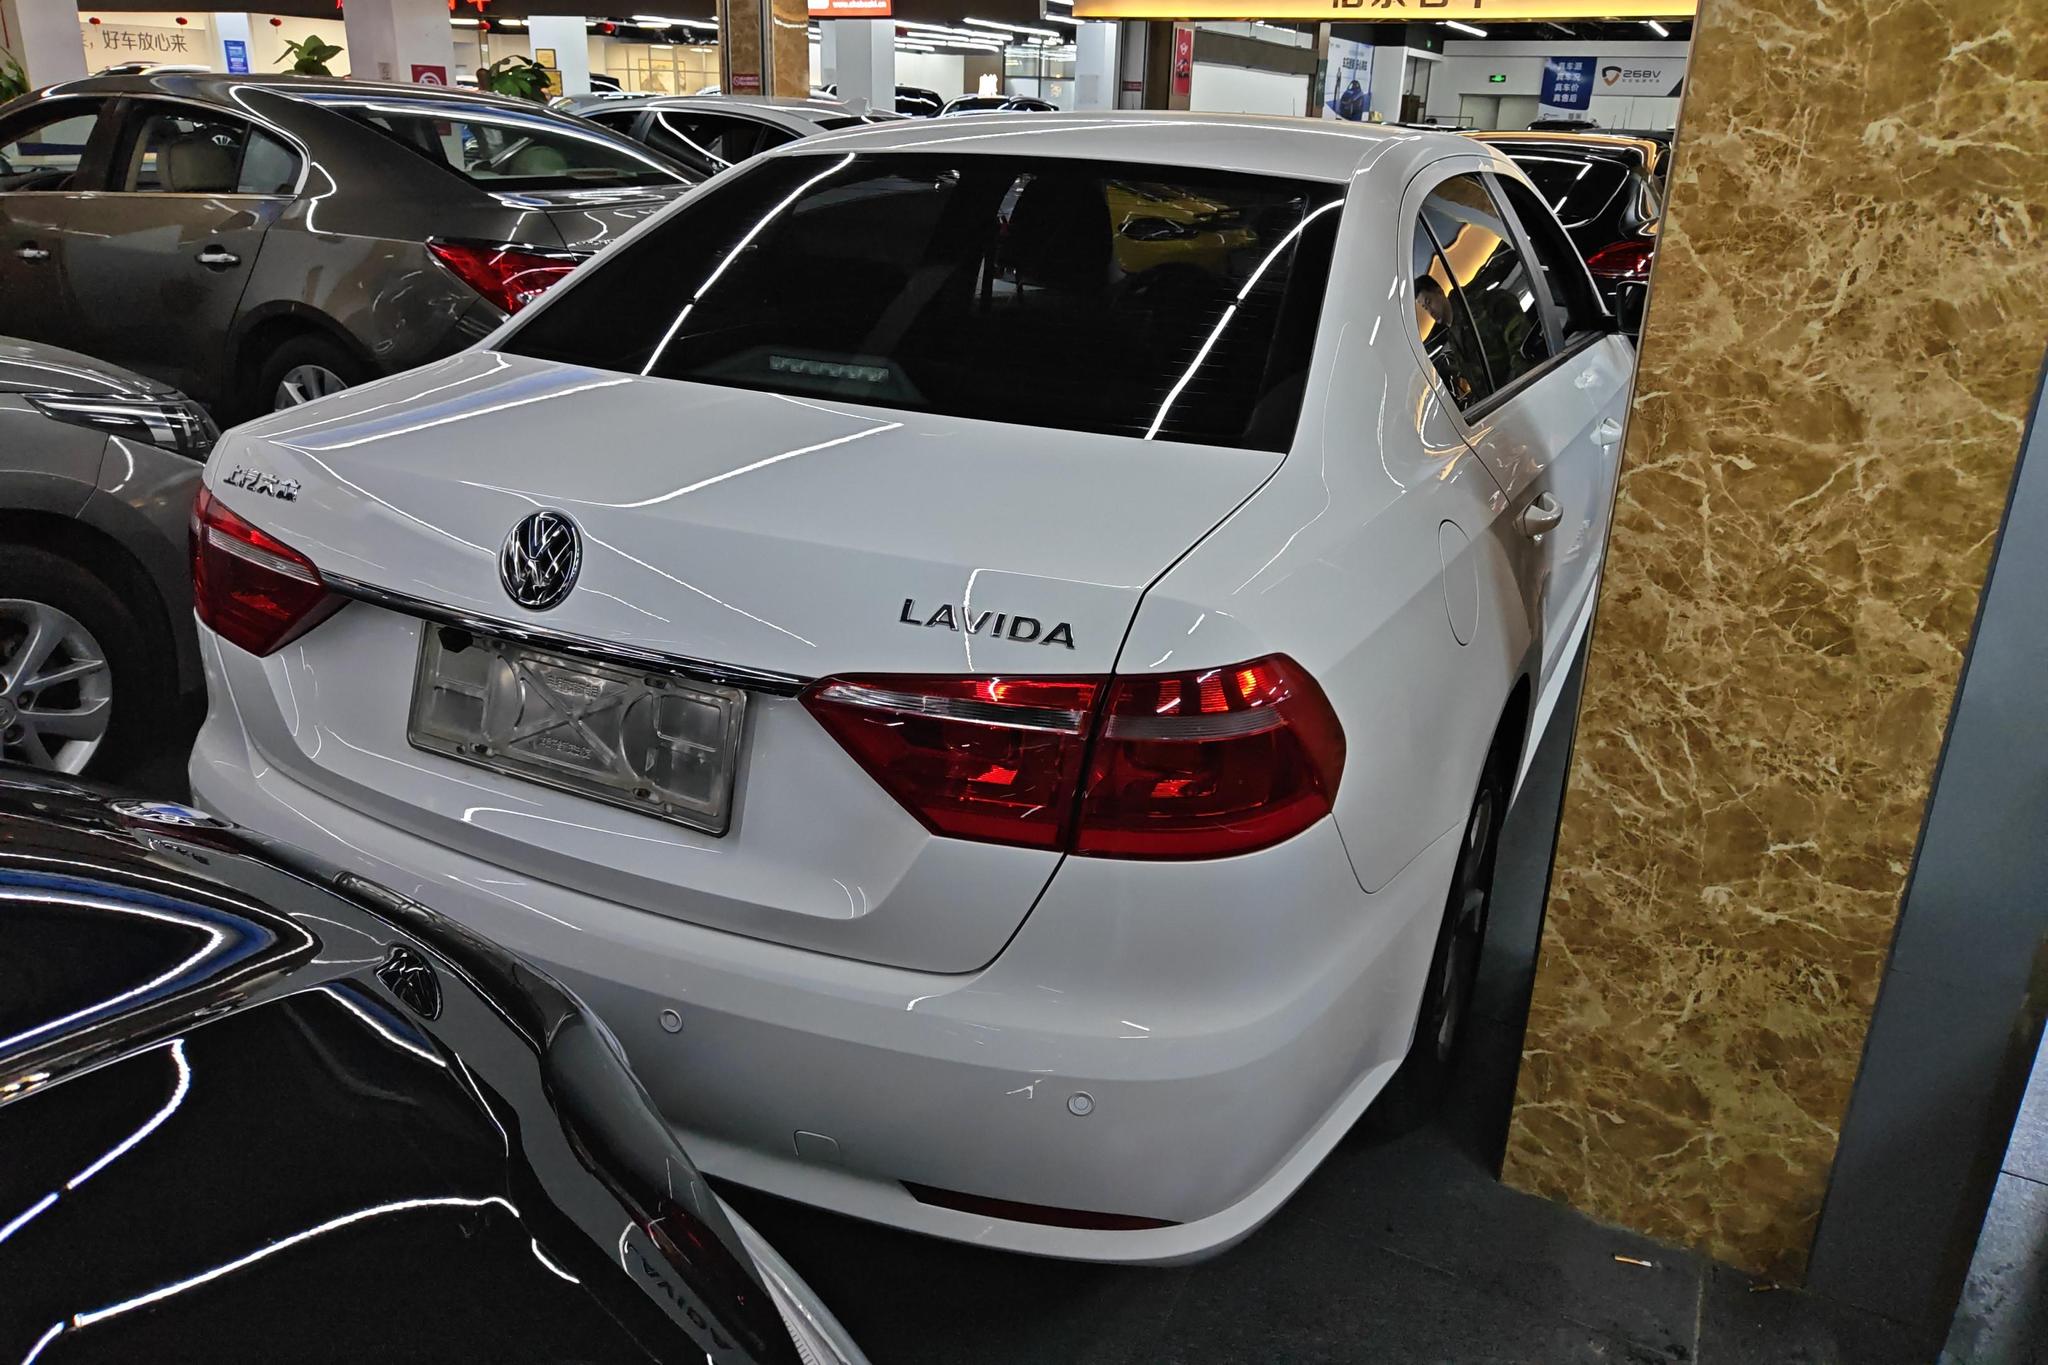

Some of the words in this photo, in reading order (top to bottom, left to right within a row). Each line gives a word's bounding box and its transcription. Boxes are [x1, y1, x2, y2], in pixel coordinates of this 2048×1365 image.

[1622, 69, 1662, 79] 268V
[1554, 82, 1580, 92] 真车价
[1552, 93, 1578, 103] 真售后
[899, 598, 1076, 651] LAVIDA
